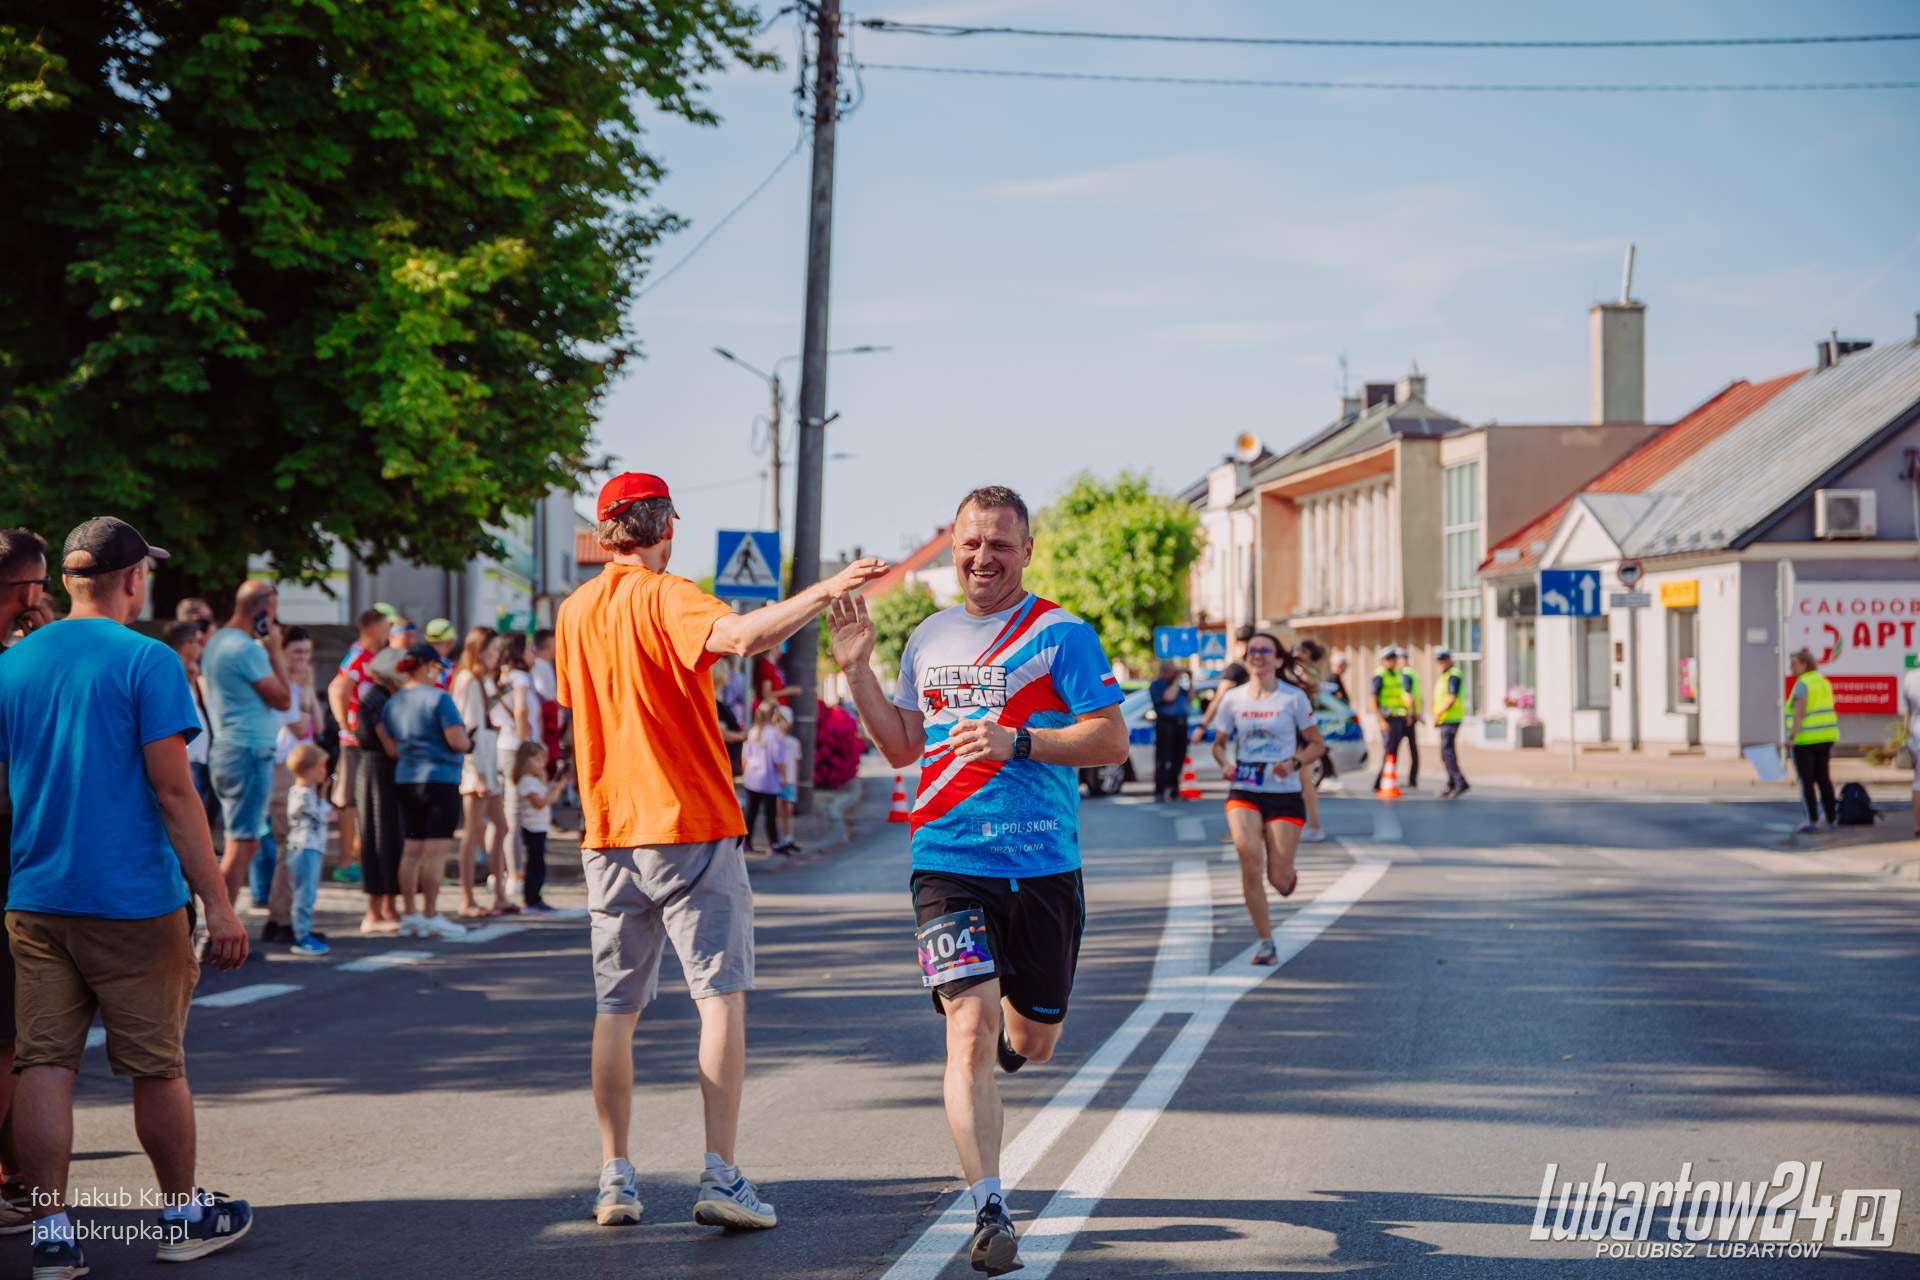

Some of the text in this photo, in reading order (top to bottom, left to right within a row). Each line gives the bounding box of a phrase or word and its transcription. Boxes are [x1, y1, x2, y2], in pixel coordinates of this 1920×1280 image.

[924, 665, 1007, 688] NIEMCE
[943, 688, 1007, 708] TEAM
[926, 928, 975, 964] 104
